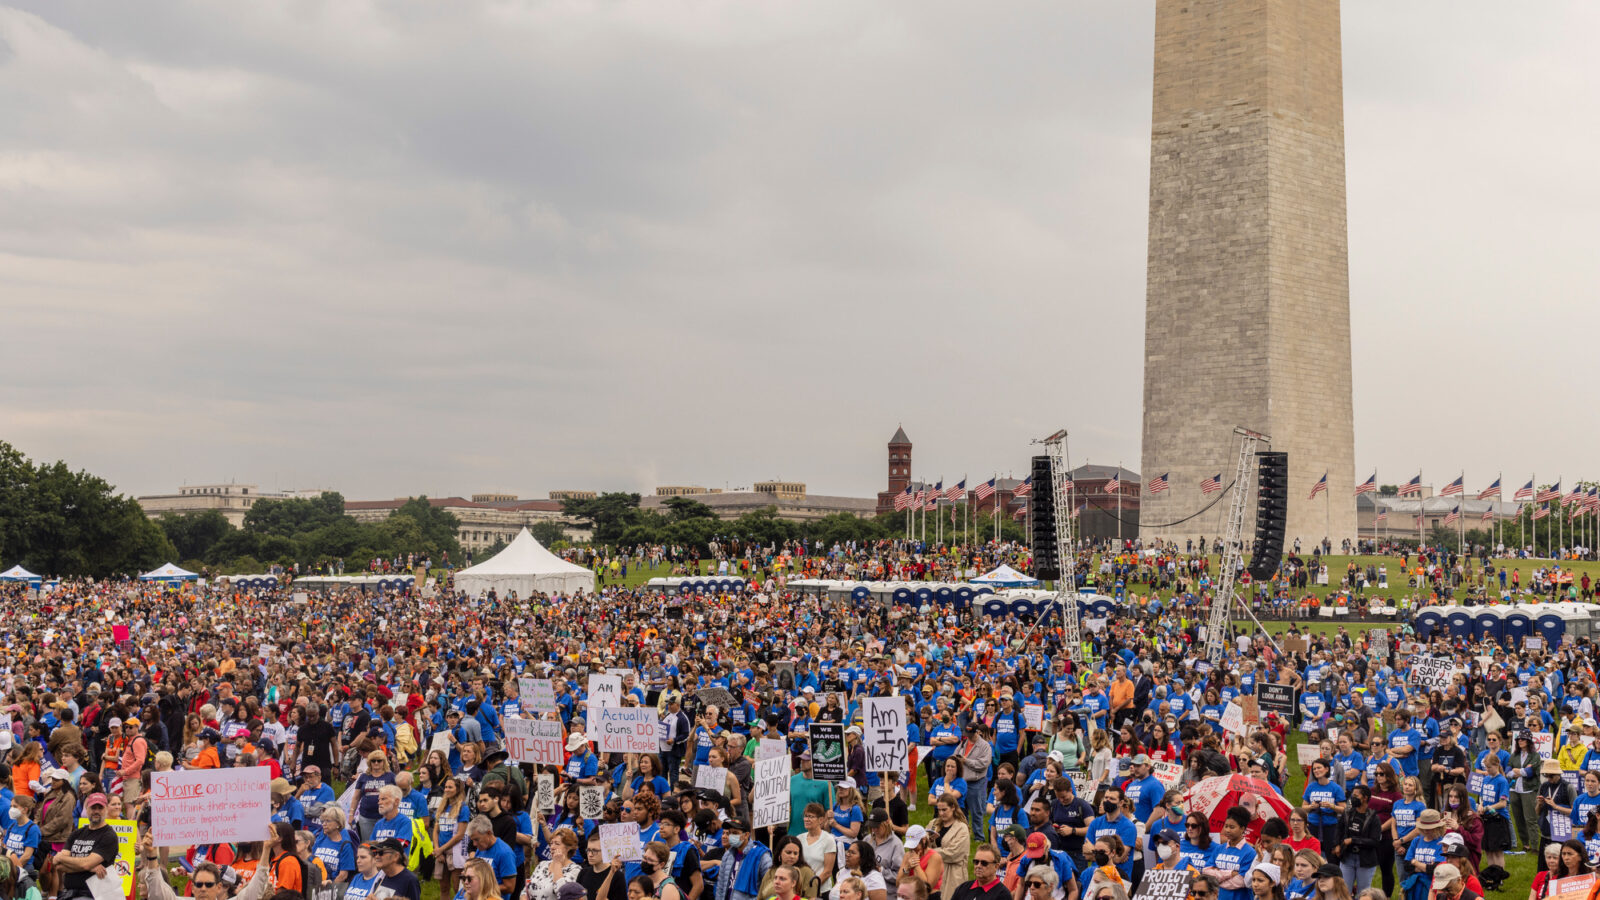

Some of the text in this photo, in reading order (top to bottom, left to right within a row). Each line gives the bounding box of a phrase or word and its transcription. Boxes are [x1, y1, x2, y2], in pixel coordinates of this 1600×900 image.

[1419, 667, 1438, 676] SAY
[598, 683, 613, 692] AM
[870, 701, 899, 728] Am
[605, 722, 654, 736] Guns DO
[604, 735, 656, 752] Kill People
[876, 729, 896, 744] I
[505, 736, 562, 763] NOT SHOT
[866, 738, 907, 770] Next?
[760, 757, 785, 779] GUN
[1153, 762, 1180, 775] CHILD IS
[154, 776, 203, 798] Shame
[206, 783, 222, 795] on
[754, 775, 789, 799] CONTROL
[155, 802, 176, 813] who
[180, 801, 205, 813] think
[172, 816, 196, 826] more
[200, 814, 237, 827] important
[753, 802, 789, 827] PRO-LIFE
[154, 830, 176, 841] than
[179, 829, 209, 841] saving
[1141, 869, 1190, 883] PROTECT
[1146, 883, 1190, 897] PEOPLE
